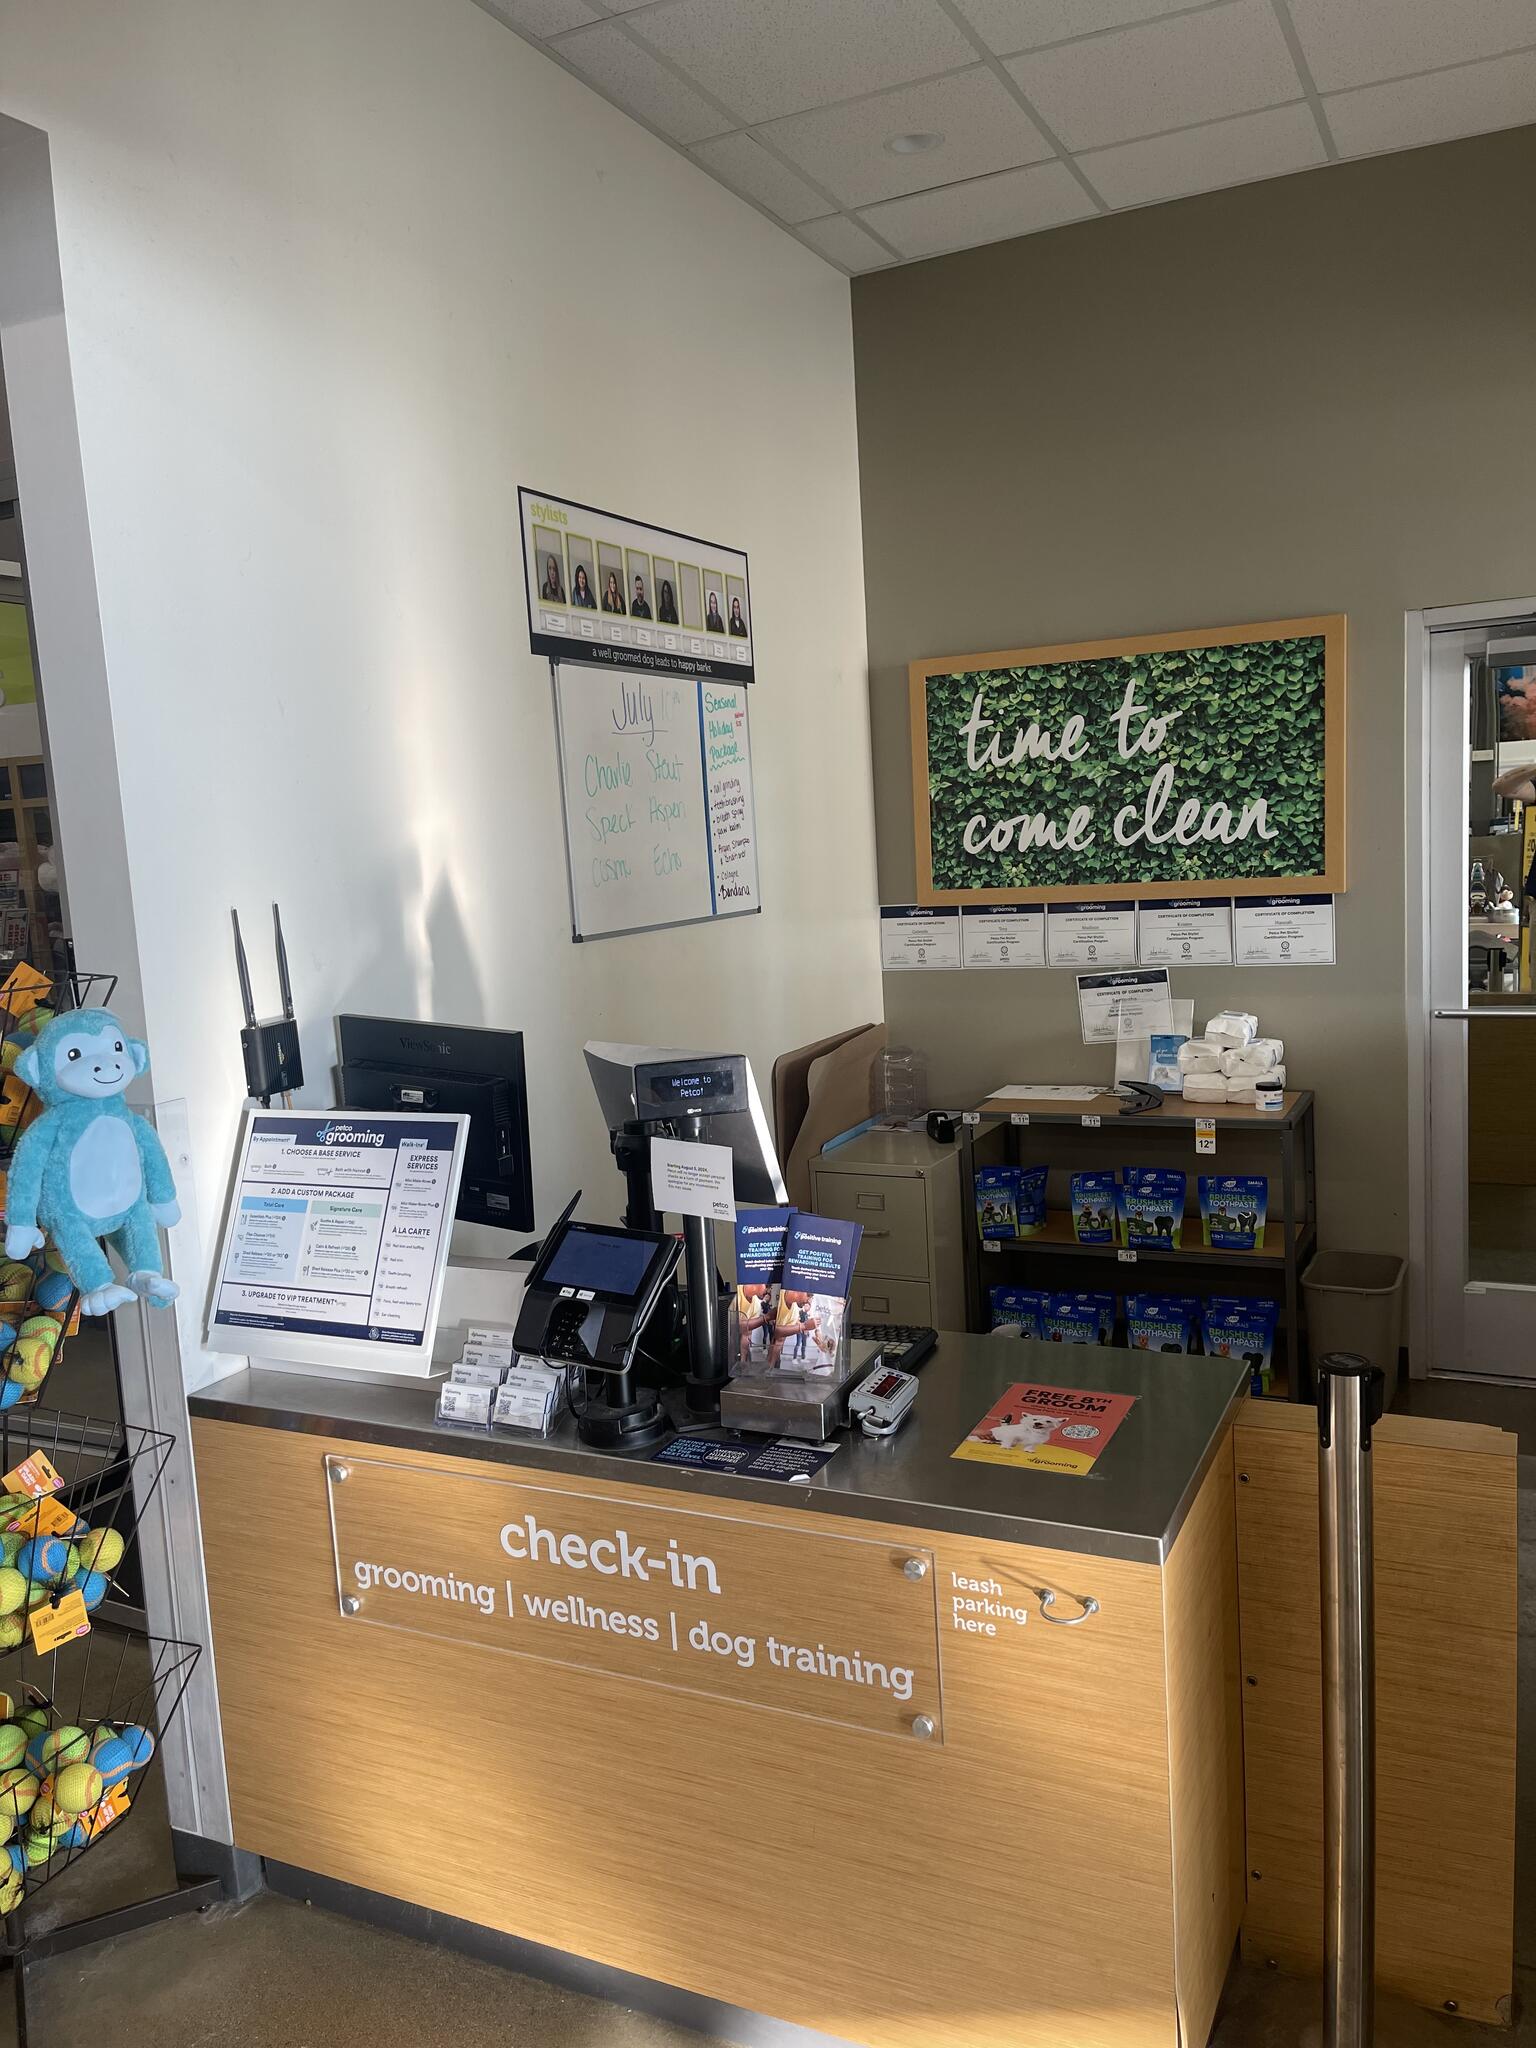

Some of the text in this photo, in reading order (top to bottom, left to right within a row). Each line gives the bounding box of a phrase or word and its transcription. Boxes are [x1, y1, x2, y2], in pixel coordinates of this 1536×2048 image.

[530, 502, 568, 525] stylists
[598, 648, 612, 658] well
[612, 651, 641, 663] groomed
[642, 654, 654, 667] dog
[655, 655, 670, 667] leads
[671, 658, 677, 668] to
[677, 658, 696, 672] happy
[612, 681, 655, 747] July
[959, 677, 1183, 771] time to
[585, 752, 633, 798] Charlie
[963, 763, 1278, 854] come clean
[720, 883, 750, 900] Bandana
[910, 908, 934, 916] grooming
[1112, 977, 1138, 985] grooming
[671, 1075, 711, 1087] Welcome to
[680, 1087, 704, 1098] Petco!
[334, 1124, 352, 1132] petco
[325, 1129, 385, 1147] grooming
[286, 1148, 312, 1156] CHOOSE
[318, 1149, 335, 1157] BASE
[335, 1150, 361, 1158] SERVICE
[410, 1154, 438, 1162] EXPRESS
[407, 1162, 438, 1170] SERVICES
[277, 1187, 291, 1195] ADD
[297, 1188, 324, 1197] CUSTOM
[325, 1190, 355, 1199] PACKAGE
[1209, 1193, 1257, 1201] BRUSHLESS
[712, 1201, 728, 1209] petco
[1125, 1198, 1174, 1207] BRUSHLESS
[1209, 1200, 1258, 1208] TOOTHPASTE
[329, 1205, 350, 1213] Signature
[1126, 1204, 1174, 1213] TOOTHPASTE
[398, 1226, 407, 1234] LA
[408, 1227, 430, 1236] CARTE
[748, 1226, 768, 1234] positive
[800, 1232, 842, 1246] positive training
[797, 1254, 821, 1262] TRAINING
[810, 1250, 833, 1258] POSITIVE
[788, 1258, 819, 1266] REWARDING
[819, 1262, 841, 1270] RESULTS
[241, 1289, 247, 1297] 3.
[248, 1290, 276, 1300] UPGRADE
[277, 1292, 286, 1301] TO
[287, 1294, 297, 1302] VIP
[993, 1317, 1036, 1328] OOTHPASTE
[1047, 1326, 1093, 1337] OOTHPASTE
[1132, 1327, 1183, 1338] OOTHPASTE
[1208, 1327, 1265, 1341] BRUSHLESS
[1025, 1389, 1113, 1404] FREE 8TH
[1021, 1396, 1107, 1413] GROOM
[709, 1452, 742, 1460] HUMANE
[713, 1448, 747, 1456] AMERICAN
[704, 1455, 738, 1464] CERTIFIED
[1034, 1459, 1078, 1470] grooming
[499, 1513, 722, 1596] check-in
[950, 1571, 1003, 1596] leash
[951, 1594, 1029, 1627] parking
[353, 1560, 915, 1701] grooming wellness dog training
[953, 1613, 998, 1637] here
